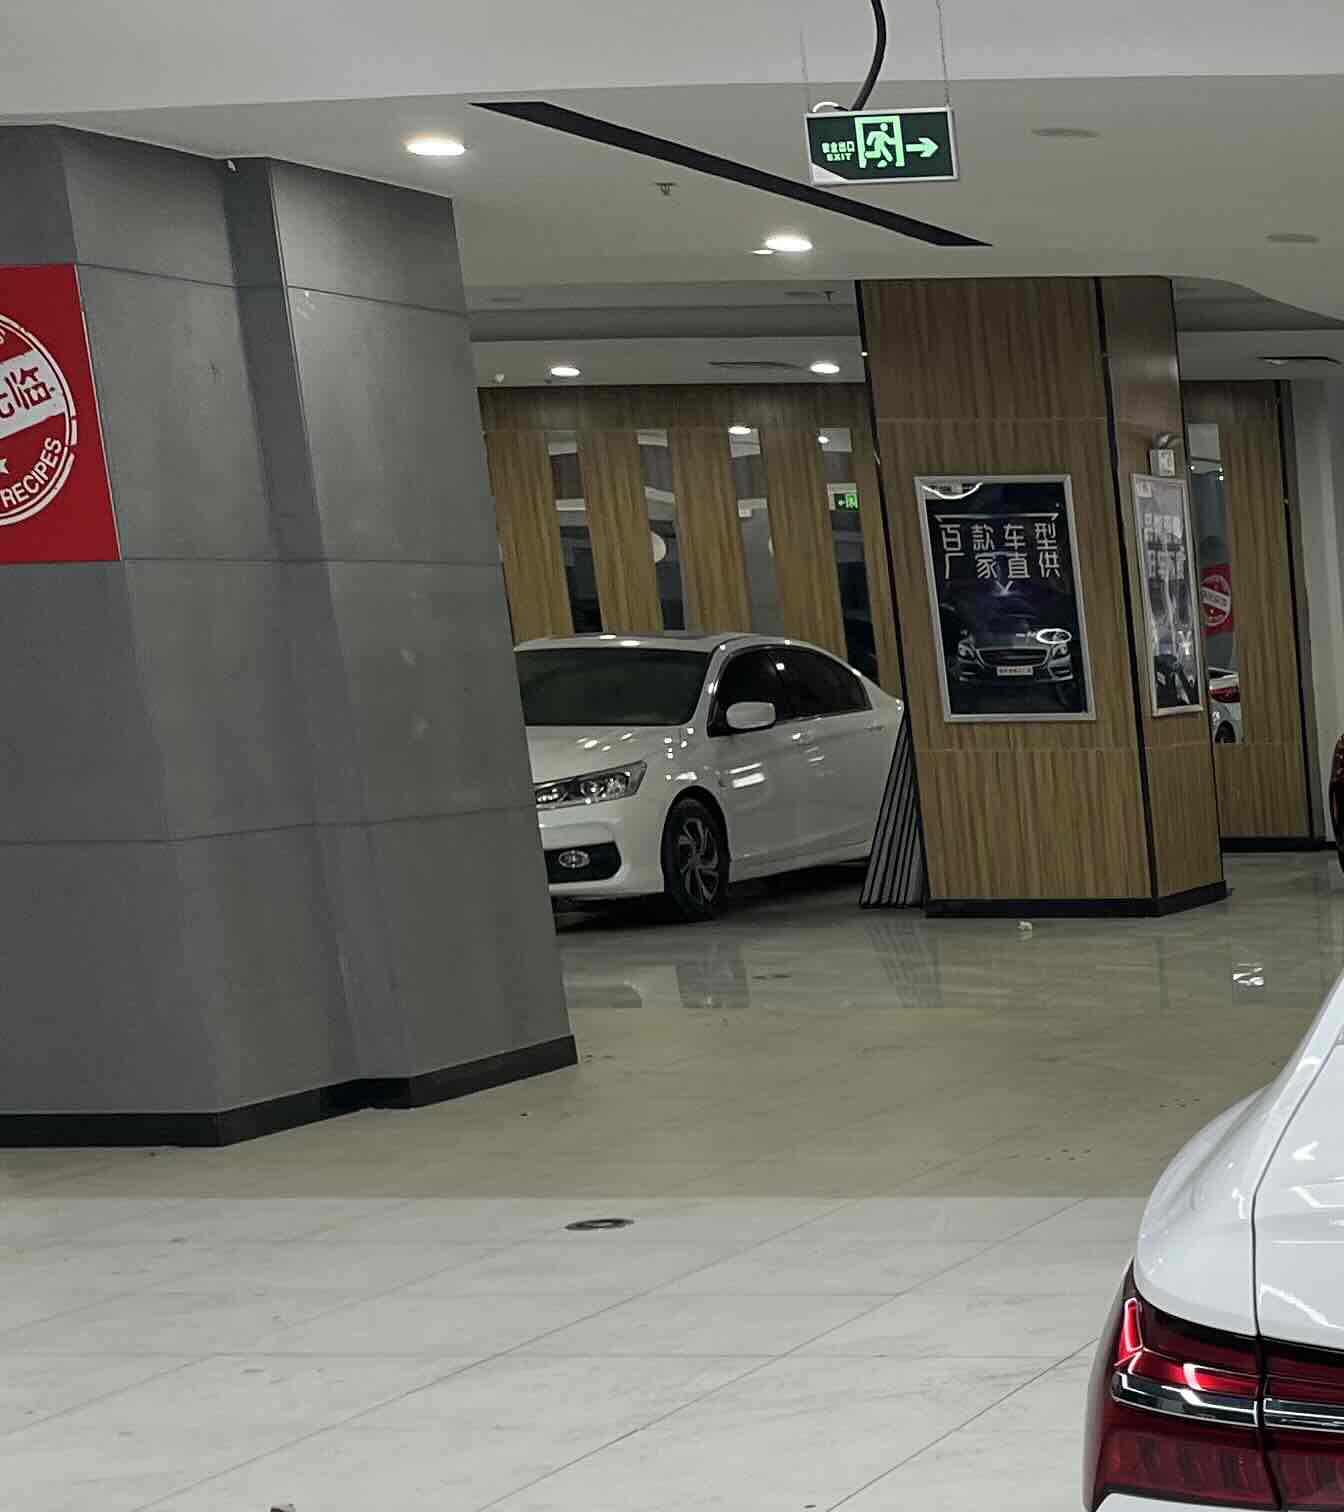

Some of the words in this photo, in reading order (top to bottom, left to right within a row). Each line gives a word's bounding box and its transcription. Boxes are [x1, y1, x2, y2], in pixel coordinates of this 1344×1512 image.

[827, 153, 852, 161] EXIT
[1, 436, 63, 508] RECIPES
[938, 522, 1057, 551] 百款车型
[944, 552, 1061, 580] 厂家直供
